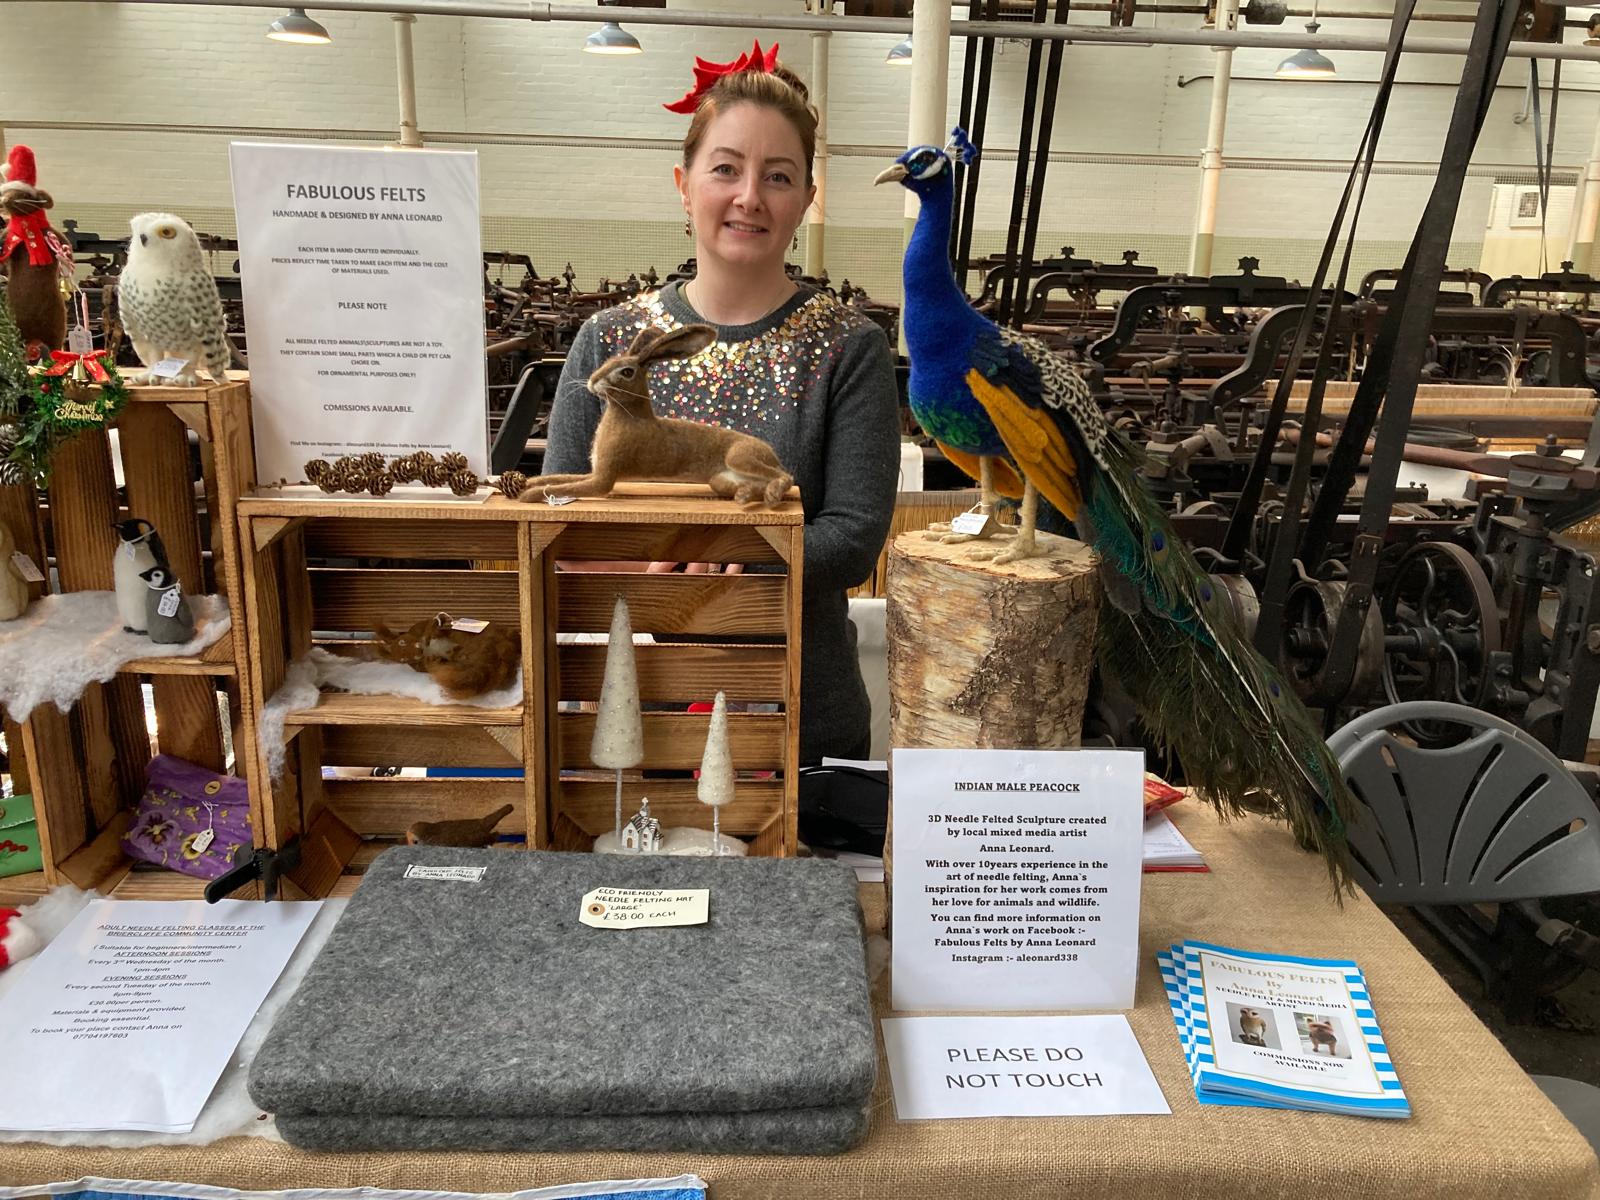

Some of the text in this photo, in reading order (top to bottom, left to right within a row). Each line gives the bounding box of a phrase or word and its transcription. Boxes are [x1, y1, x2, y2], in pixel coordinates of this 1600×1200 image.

[287, 184, 426, 202] FABULOUS FELTS
[272, 210, 318, 219] HANDMADE
[321, 211, 327, 219] &
[329, 212, 367, 220] DESIGNED
[381, 213, 403, 221] ANNA
[406, 214, 442, 222] LEONARD
[338, 301, 387, 310] PLEASE NOTE
[323, 404, 414, 413] COMISSIONS AVAILABLE.
[954, 782, 1080, 792] INDIAN MALE PEACOCK
[928, 815, 1107, 826] 3D Needle Felted Sculpture created
[947, 828, 1087, 838] by local mixed media artist
[1009, 844, 1054, 852] Leonard.
[926, 860, 950, 868] With
[979, 860, 1018, 870] 10years
[1020, 861, 1076, 870] experience
[1092, 860, 1108, 869] the
[964, 873, 974, 881] of
[976, 873, 1010, 881] needle
[1012, 873, 1049, 883] felting,
[925, 885, 981, 895] inspiration
[983, 885, 998, 893] for
[1000, 885, 1018, 894] her
[1020, 886, 1047, 894] work
[1083, 885, 1108, 894] from
[932, 898, 1100, 907] her love for animals and wildlife.
[931, 914, 950, 922] You
[974, 914, 994, 922] find
[1025, 914, 1086, 922] information
[983, 926, 1009, 934] work
[1027, 926, 1076, 934] Facebook
[934, 938, 980, 947] Fabulous
[983, 938, 1008, 947] Felts
[1010, 938, 1023, 948] by
[1055, 938, 1096, 946] Leonard
[952, 954, 1003, 963] Instagram
[1016, 954, 1078, 962] aleonard338
[1210, 961, 1337, 984] FABULOUS FELTS
[1266, 981, 1282, 989] By
[1216, 986, 1250, 997] NEEDLE
[1286, 998, 1316, 1006] MIXED
[1231, 982, 1324, 1002] Anna Leonard
[947, 1048, 1083, 1062] PLEASE DO
[1253, 1051, 1320, 1065] COMMISSIONS
[1274, 1060, 1328, 1072] AVAILABLE
[946, 1073, 1103, 1088] NOT TOUCH
